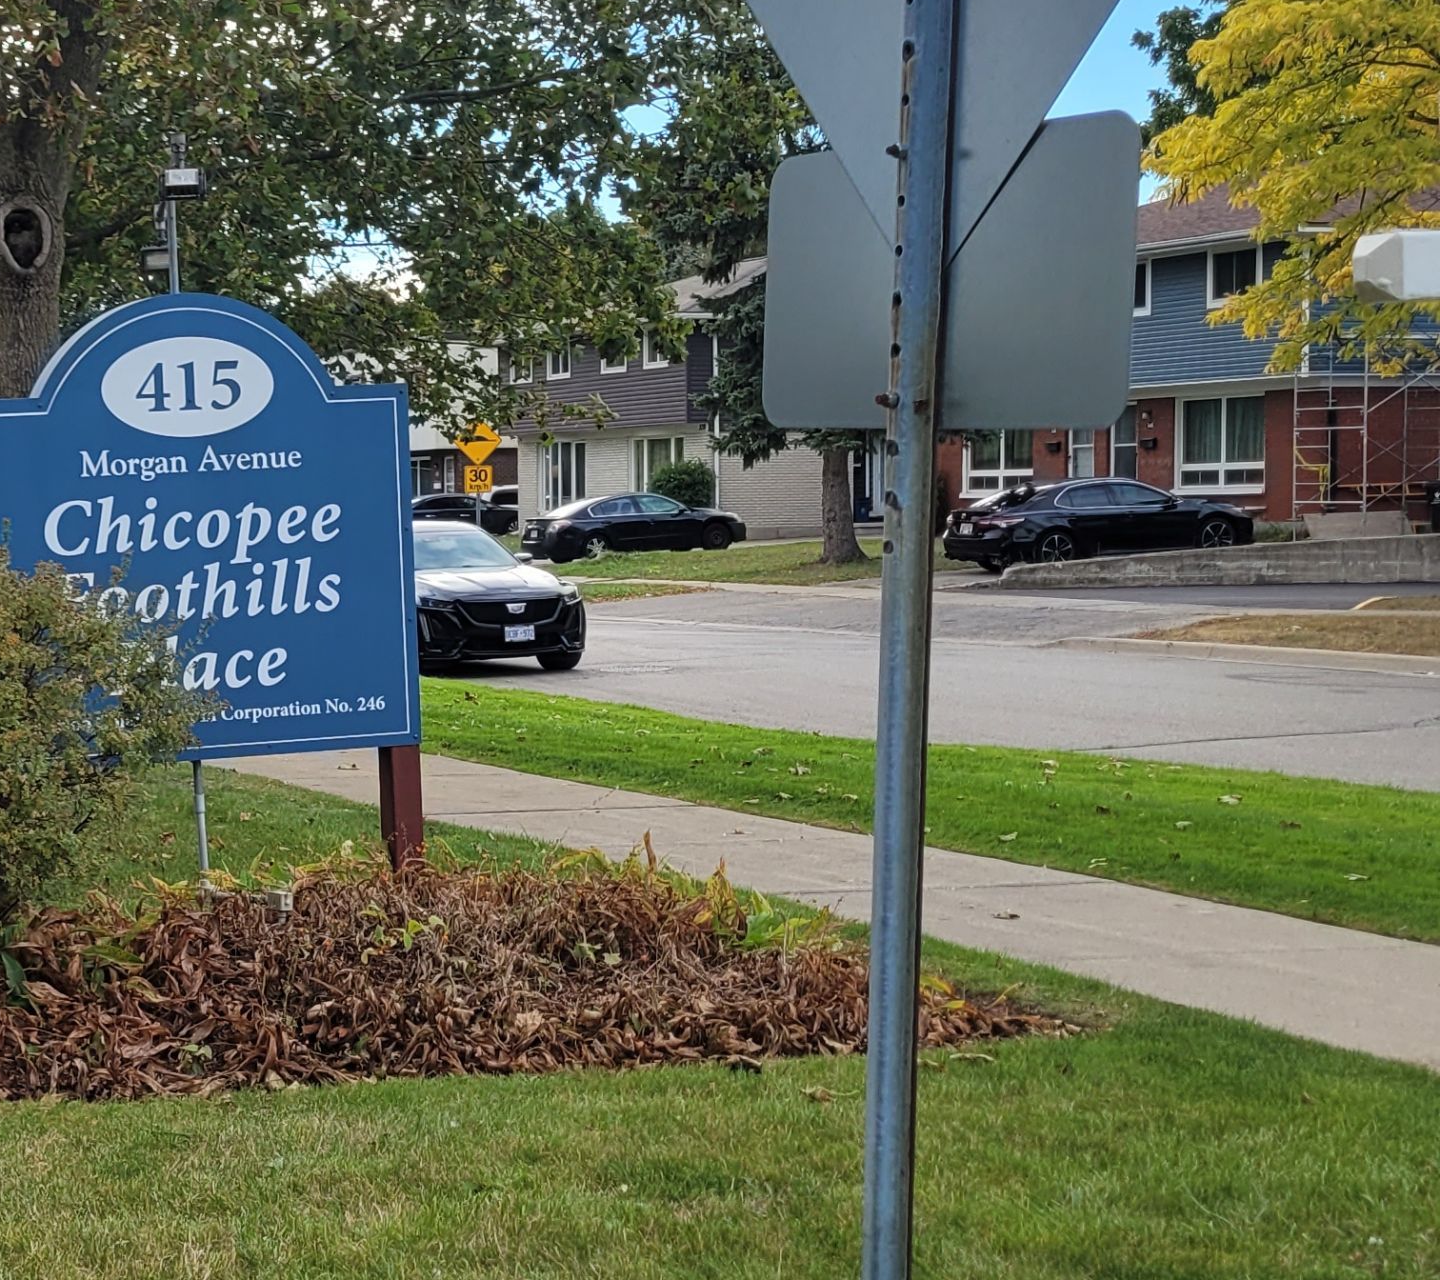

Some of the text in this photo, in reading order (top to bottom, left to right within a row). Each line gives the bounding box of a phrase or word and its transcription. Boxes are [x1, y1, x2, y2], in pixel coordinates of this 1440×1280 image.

[135, 360, 241, 413] 415
[79, 444, 303, 482] Morgan Avenue
[469, 469, 489, 482] 30
[469, 482, 489, 492] km/h
[43, 495, 342, 565] Chicopee
[220, 700, 322, 724] Corporation
[324, 697, 354, 715] No.
[356, 695, 386, 711] 246
